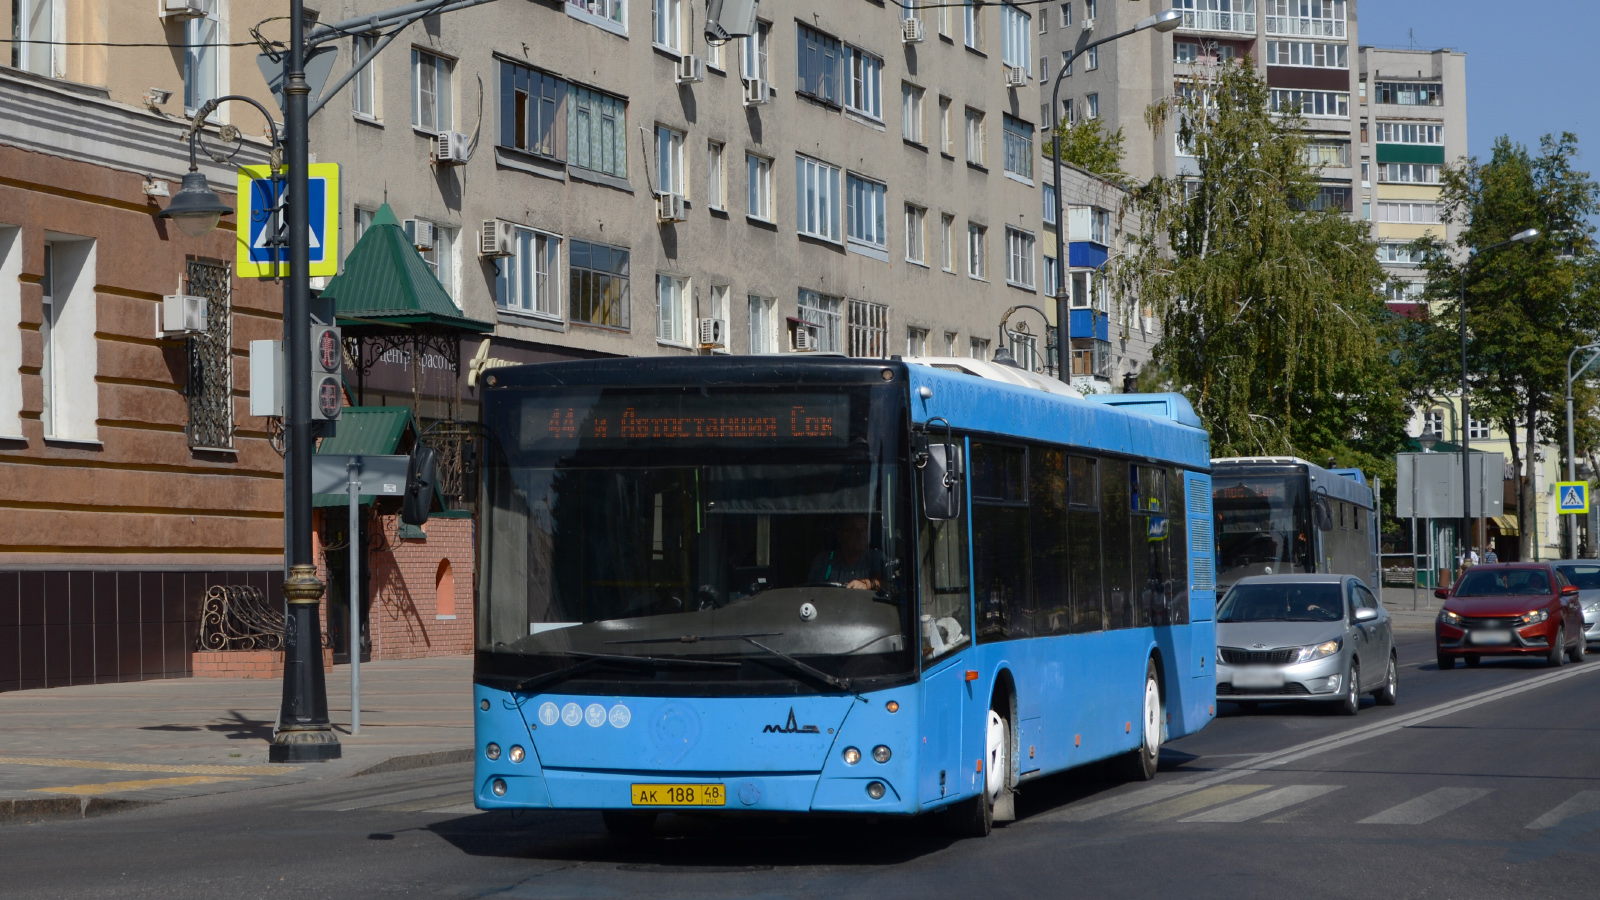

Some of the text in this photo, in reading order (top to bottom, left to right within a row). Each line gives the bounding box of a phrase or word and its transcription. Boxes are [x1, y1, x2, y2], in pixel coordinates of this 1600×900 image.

[549, 408, 575, 438] 44
[621, 407, 777, 438] Автостанция
[640, 786, 720, 803] АК 188 48
